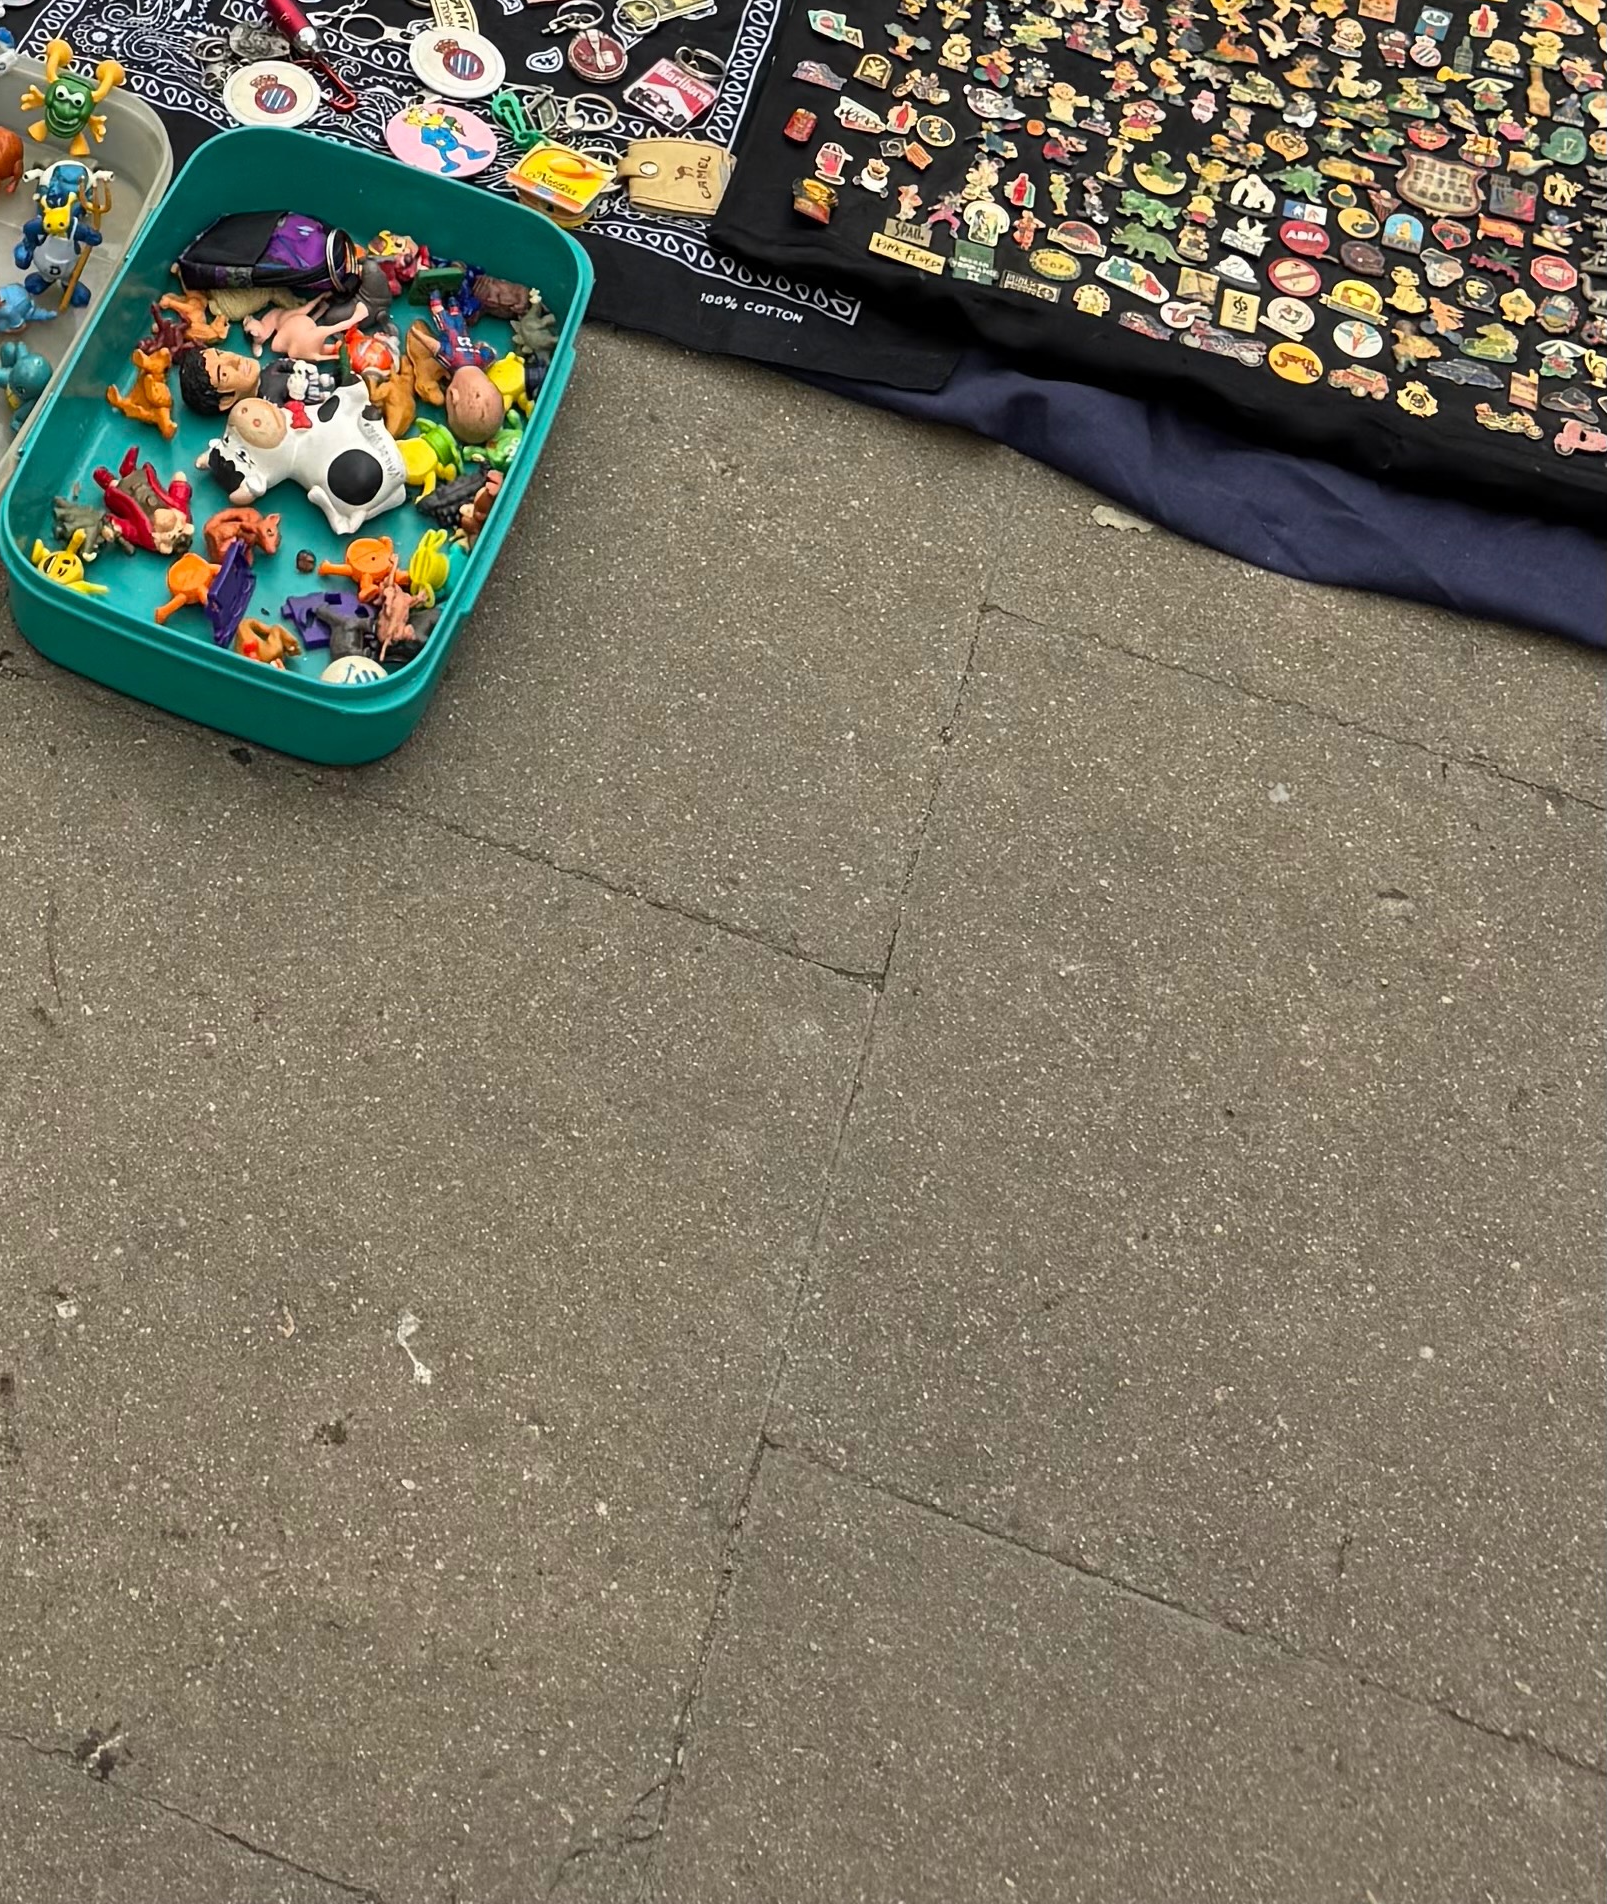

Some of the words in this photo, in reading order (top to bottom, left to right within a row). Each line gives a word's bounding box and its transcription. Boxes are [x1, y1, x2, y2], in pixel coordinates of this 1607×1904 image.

[696, 155, 712, 199] CAMEL
[1286, 229, 1324, 243] ADIA
[700, 293, 738, 310] 100%
[744, 301, 803, 324] COTTON
